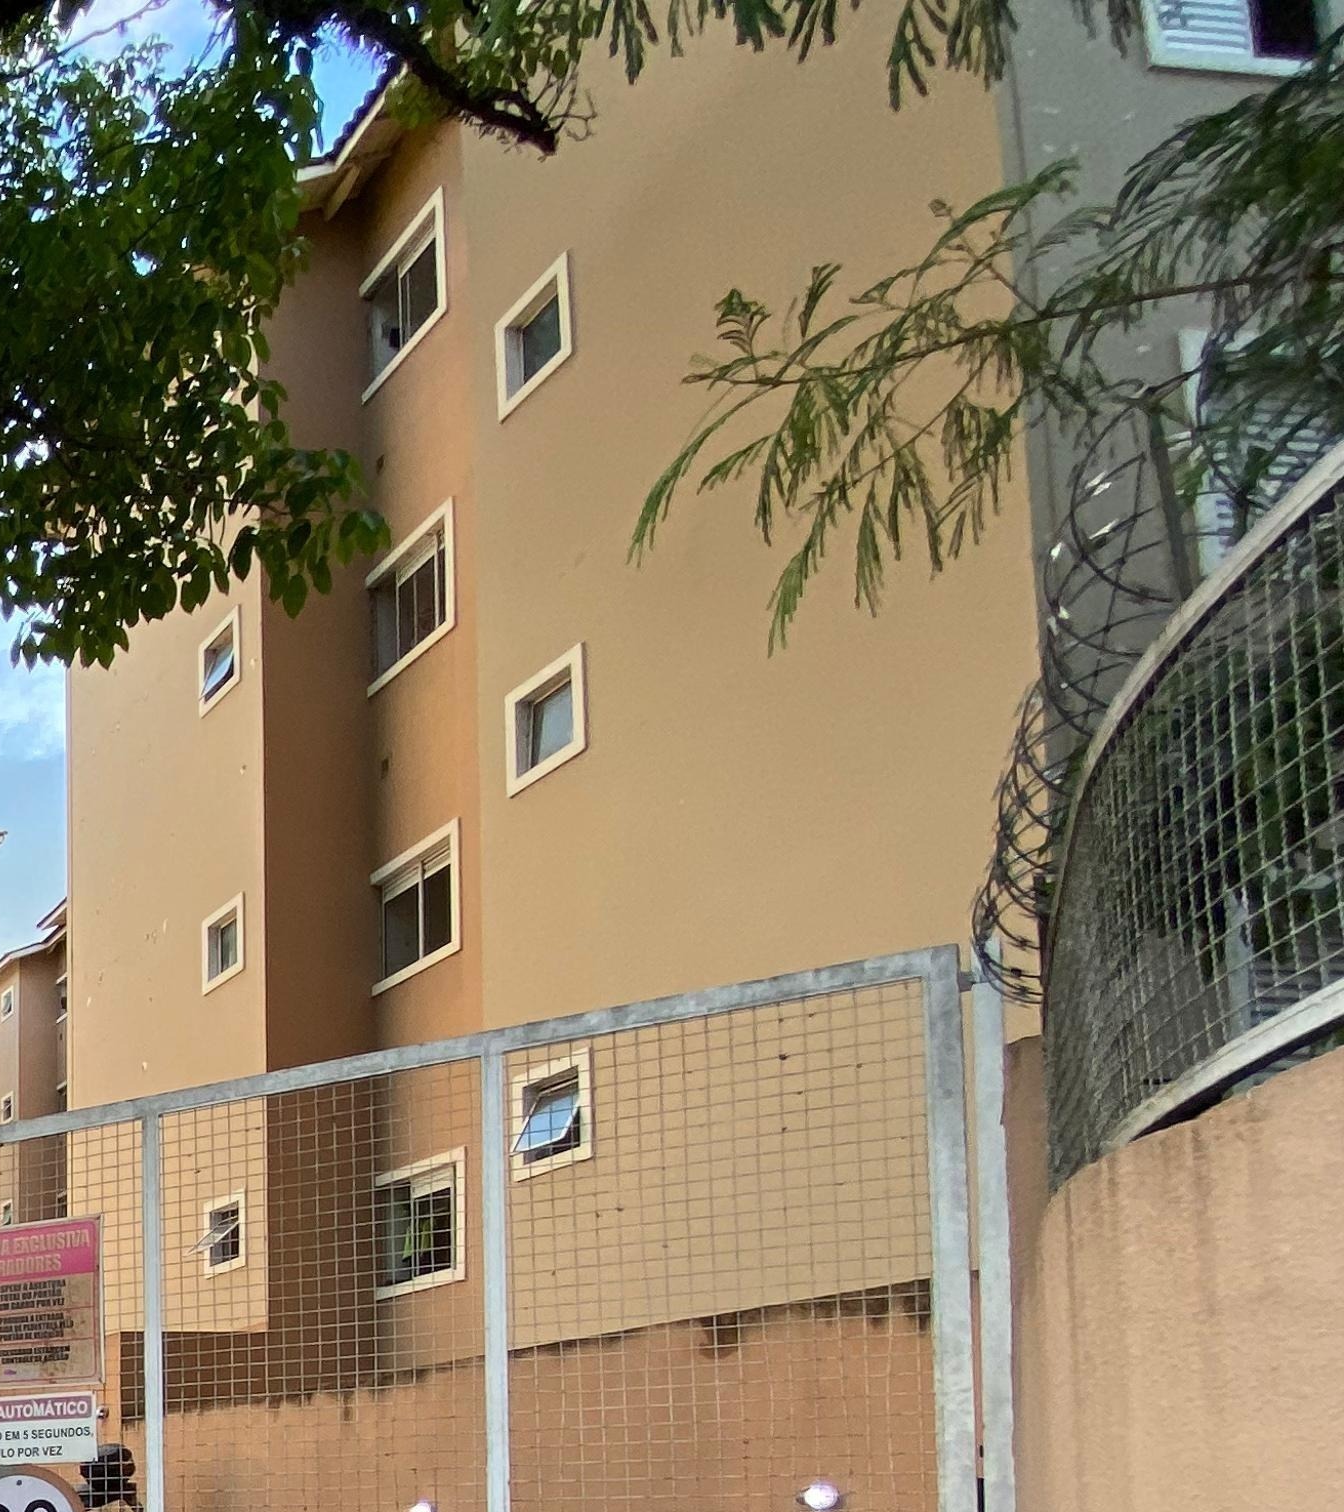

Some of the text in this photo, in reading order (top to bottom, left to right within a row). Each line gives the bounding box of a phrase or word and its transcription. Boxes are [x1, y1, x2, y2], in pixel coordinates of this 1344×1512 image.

[13, 1229, 90, 1252] EXCLUSIVA
[5, 1430, 20, 1441] EM
[23, 1429, 29, 1440] 5
[31, 1426, 94, 1440] SEGUNDOS,
[17, 1446, 40, 1458] POR
[42, 1445, 63, 1456] VEZ
